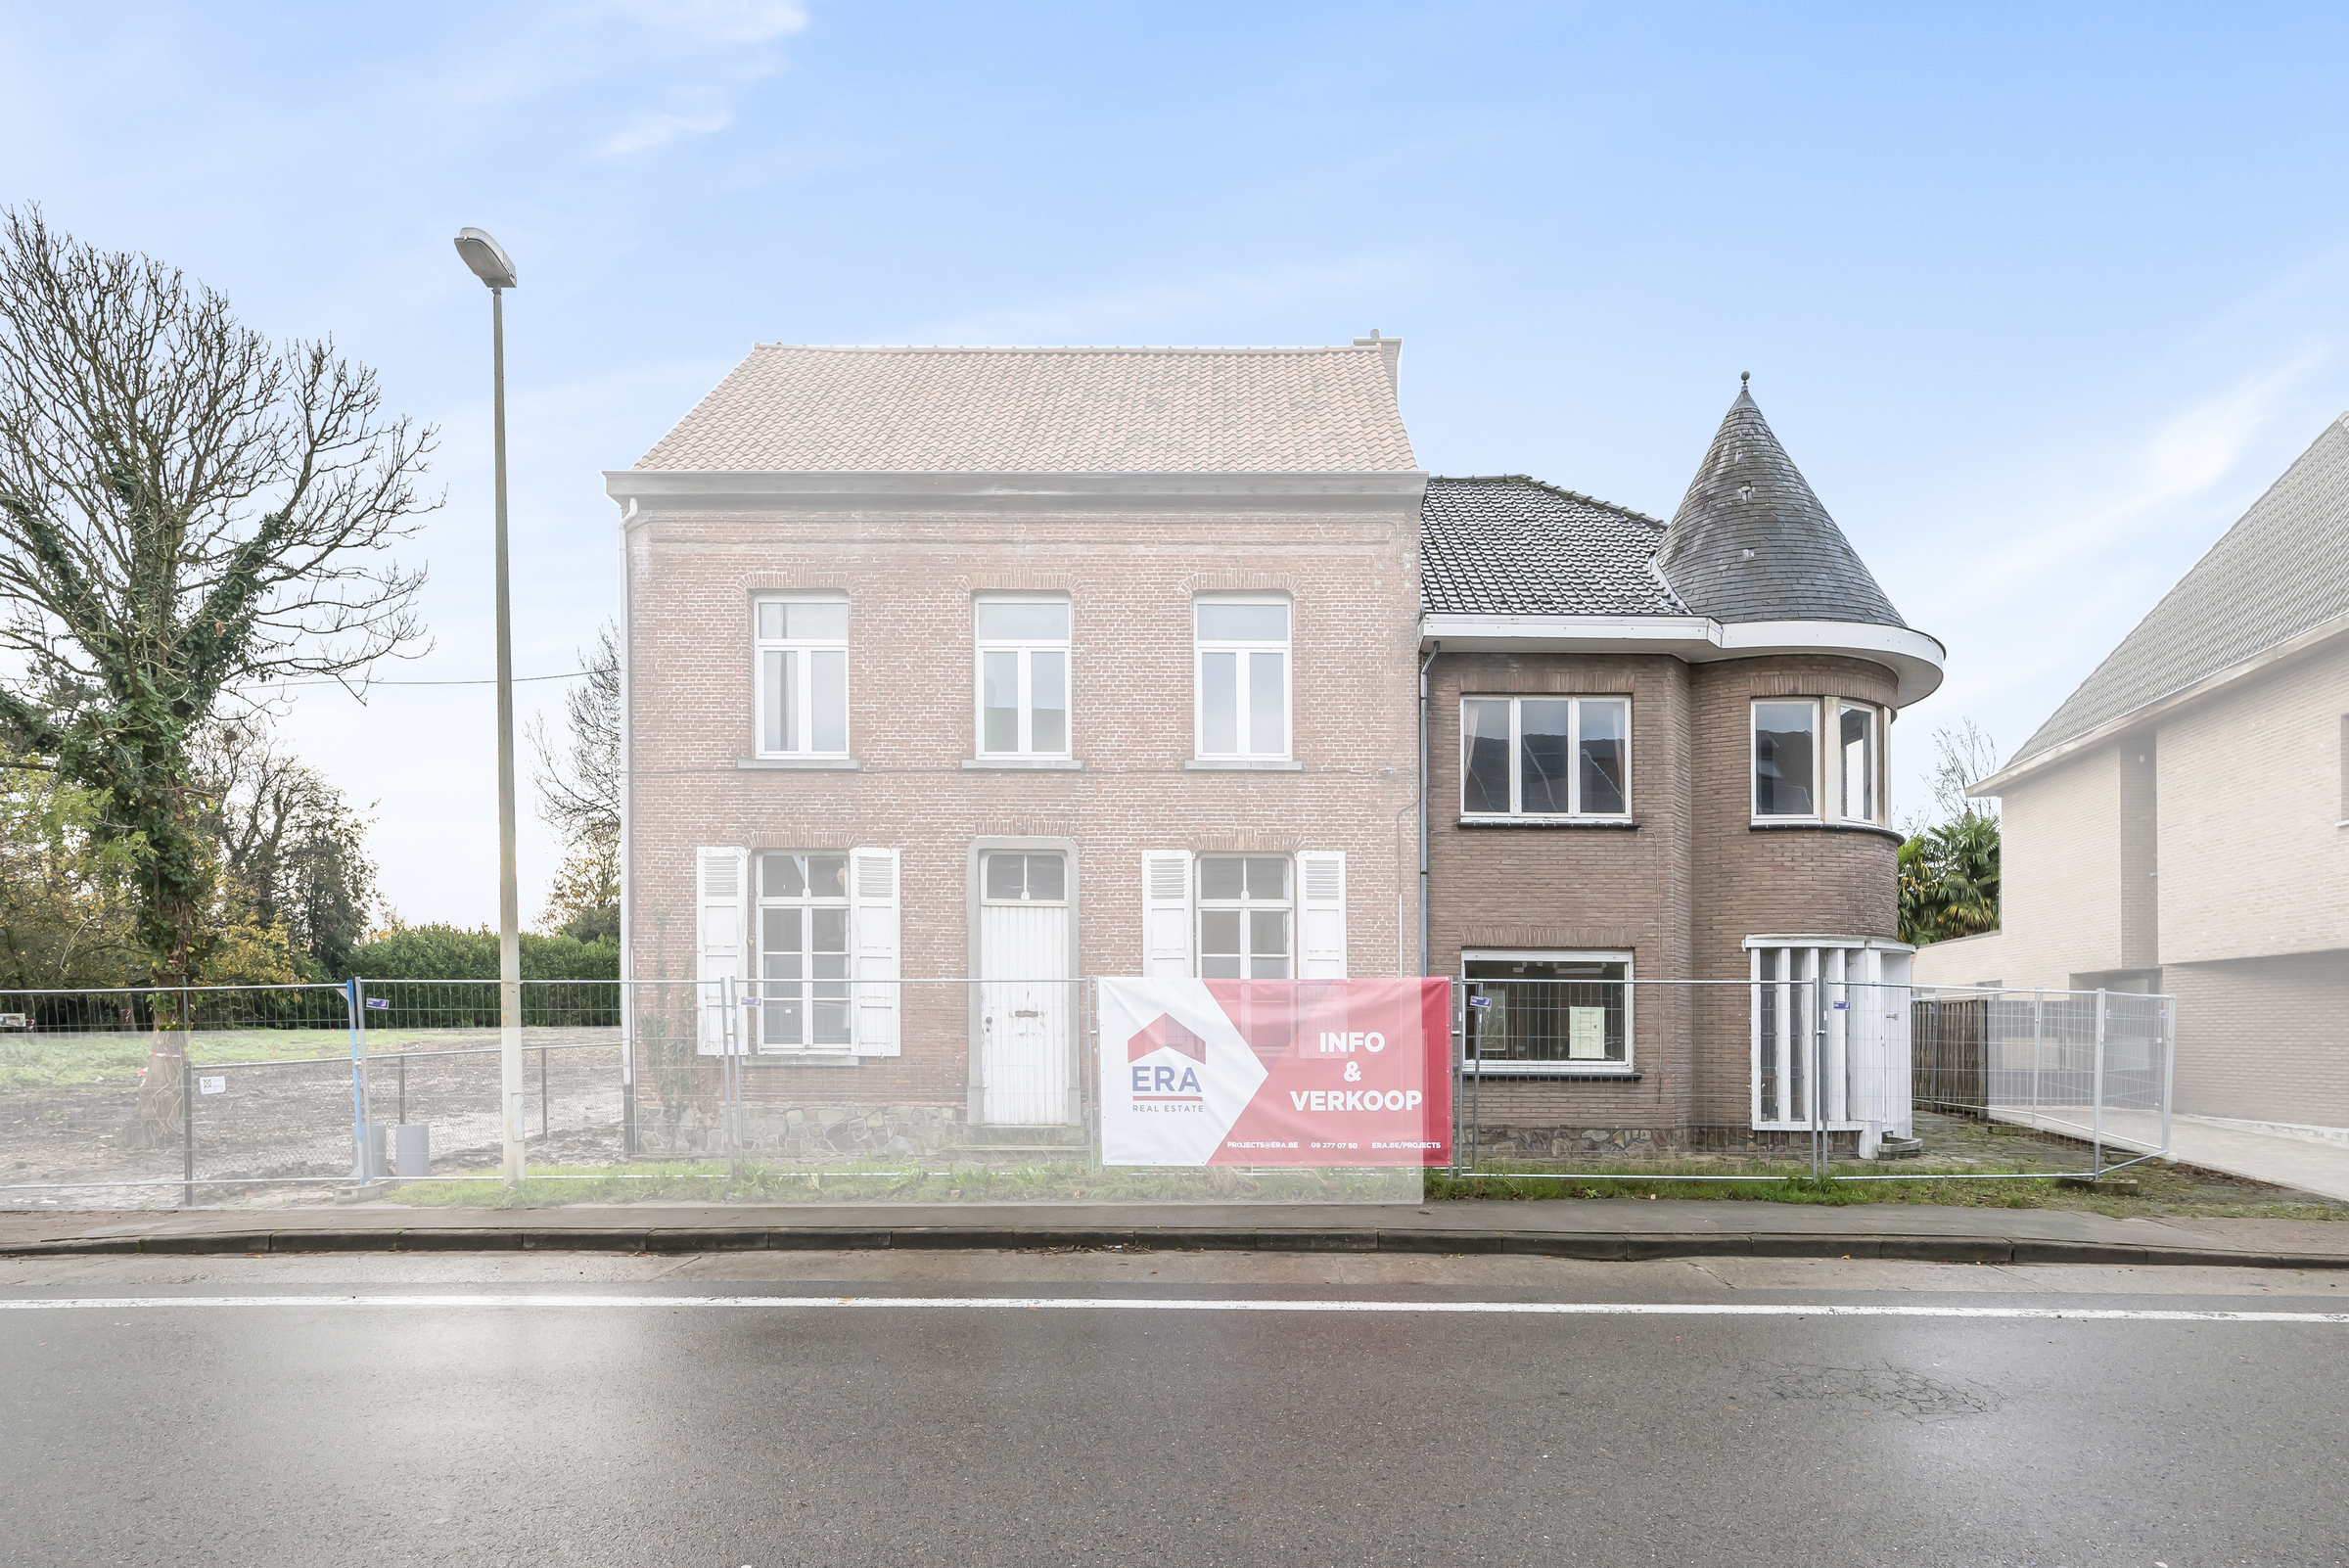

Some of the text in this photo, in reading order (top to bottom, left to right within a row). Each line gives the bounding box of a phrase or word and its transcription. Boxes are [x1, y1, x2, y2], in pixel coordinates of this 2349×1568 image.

[1319, 1032, 1385, 1052] INFO
[1131, 1066, 1202, 1092] ERA
[1343, 1061, 1361, 1082] &
[1289, 1090, 1422, 1111] VERKOOP
